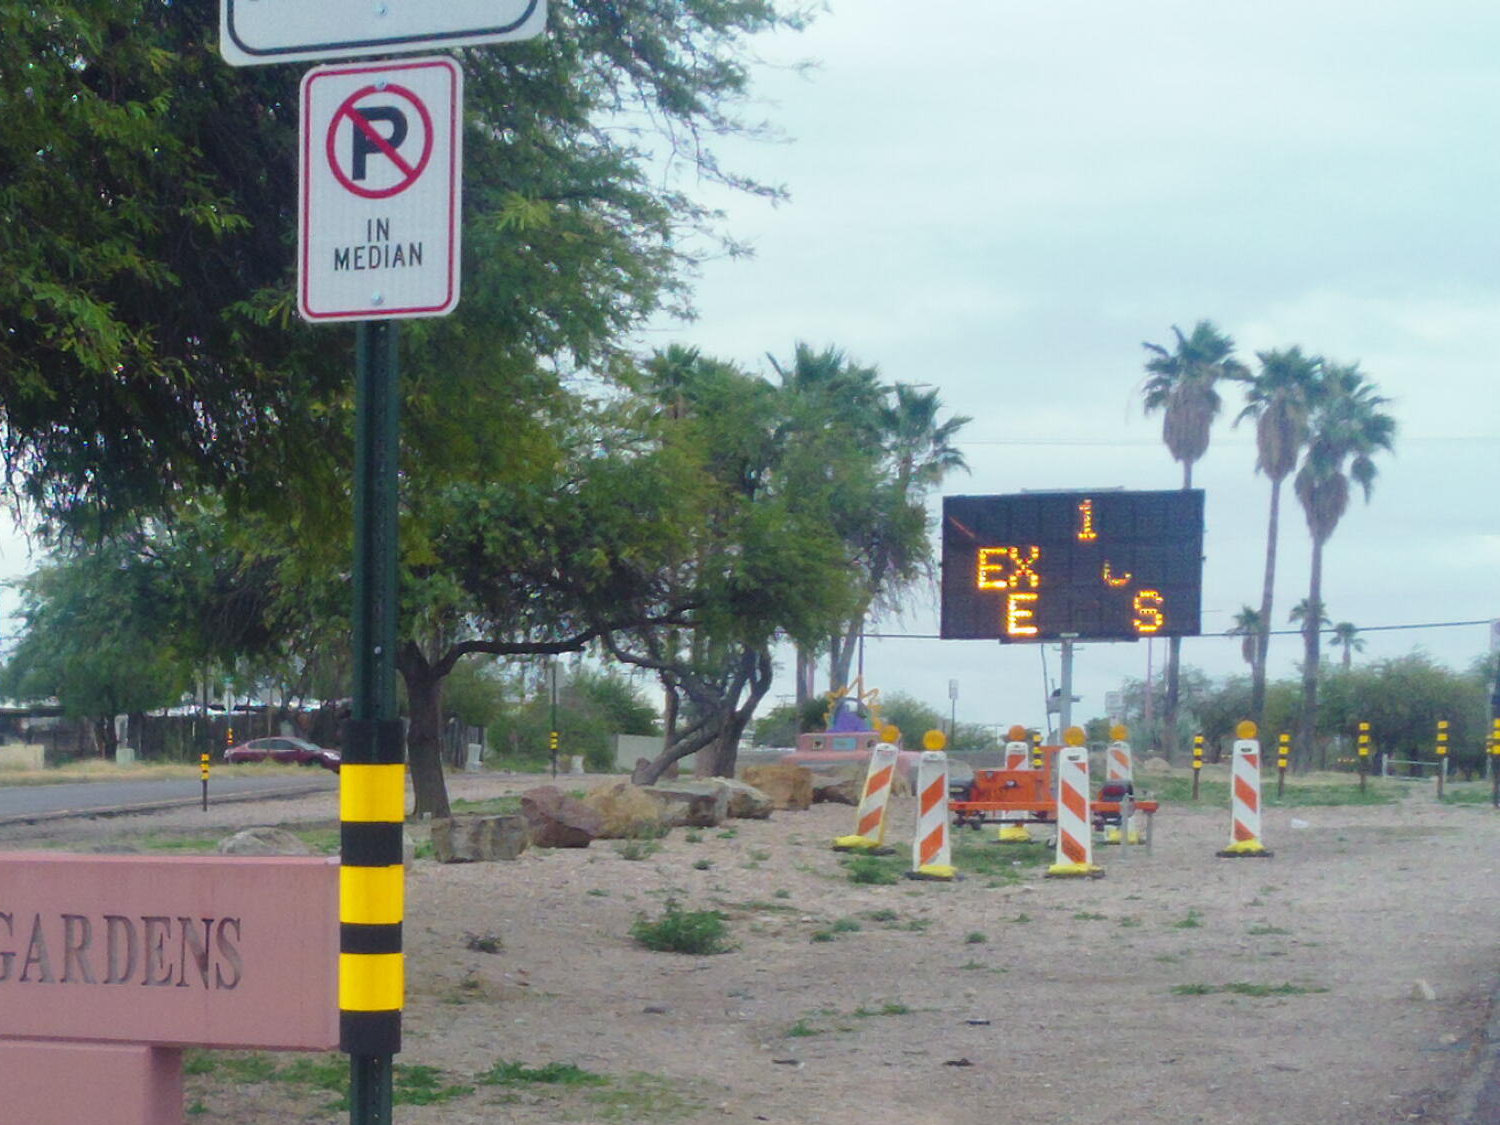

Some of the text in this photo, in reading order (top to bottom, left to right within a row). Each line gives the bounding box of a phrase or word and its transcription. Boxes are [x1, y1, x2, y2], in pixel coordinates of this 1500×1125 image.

[352, 105, 408, 181] P
[367, 218, 390, 242] IN
[334, 242, 423, 271] MEDIAN
